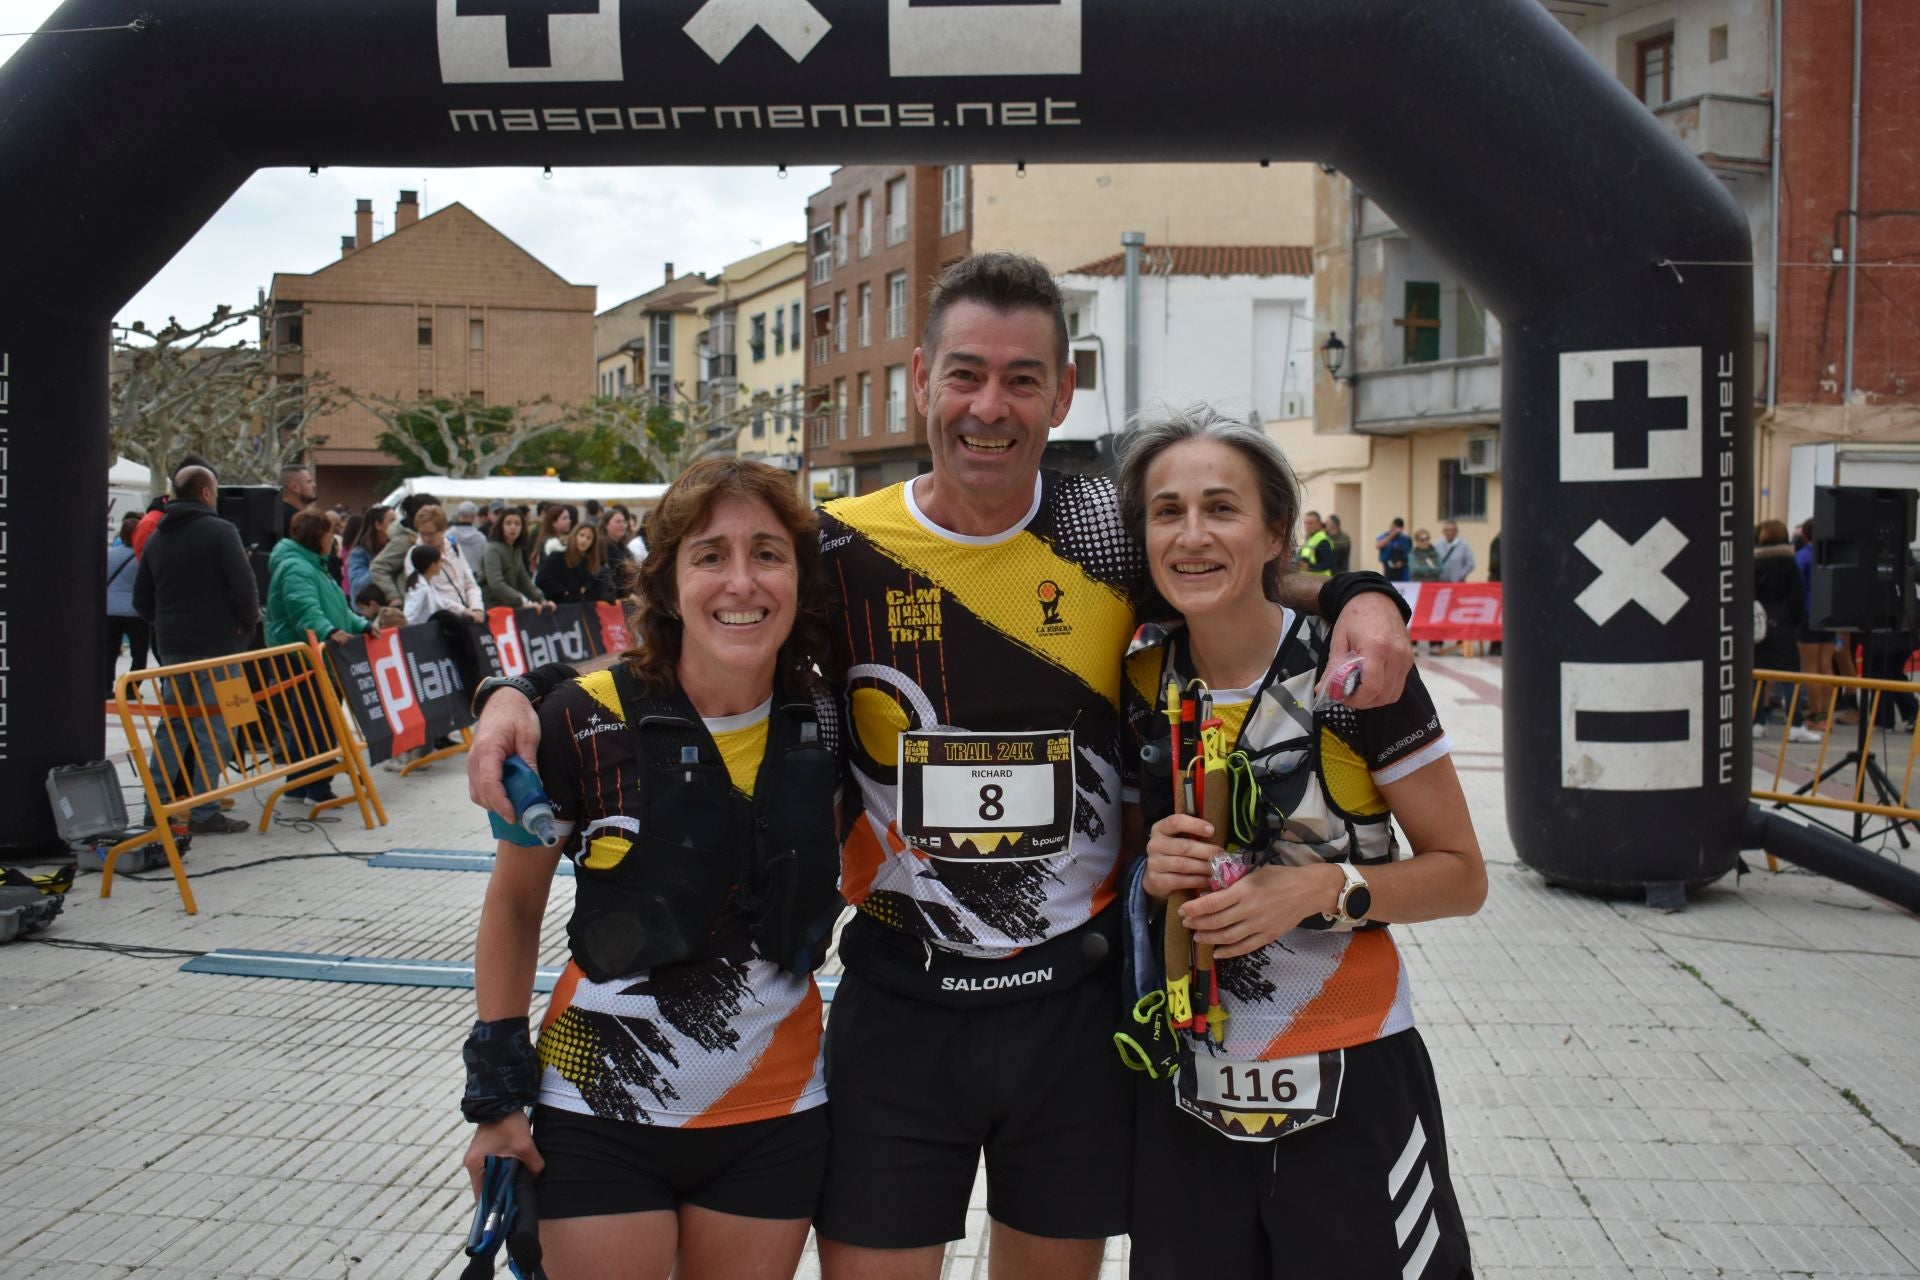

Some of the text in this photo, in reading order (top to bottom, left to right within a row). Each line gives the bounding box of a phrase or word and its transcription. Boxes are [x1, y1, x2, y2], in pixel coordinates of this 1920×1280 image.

[449, 98, 1081, 133] maspormenos.net
[1718, 351, 1734, 785] maspormenos.net
[573, 722, 625, 742] TEAMERGY
[1377, 729, 1424, 762] SEGURIDAD
[944, 742, 1034, 761] TRAIL 24K
[971, 769, 1013, 778] RICHARD
[978, 784, 1005, 821] 8
[941, 967, 1053, 991] SALOMON
[1153, 1013, 1163, 1041] LEKI
[1219, 1065, 1298, 1103] 116
